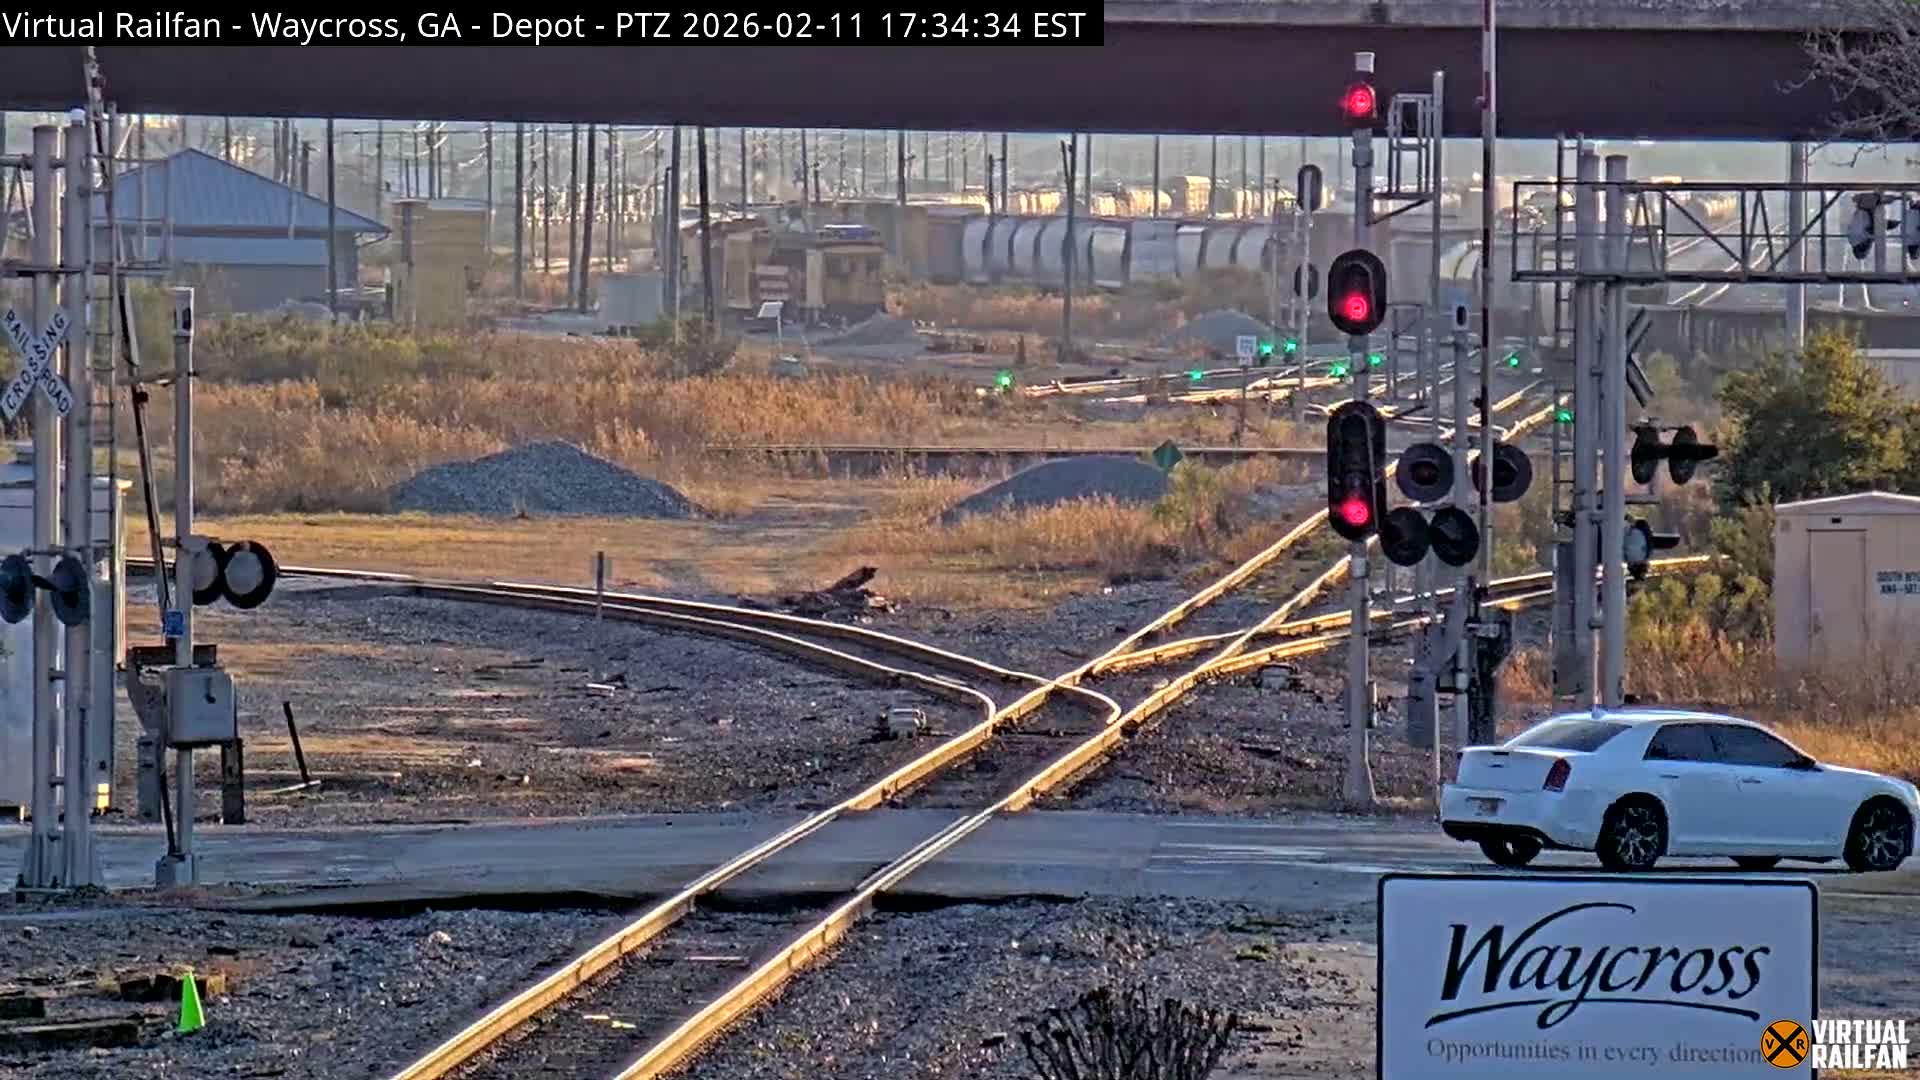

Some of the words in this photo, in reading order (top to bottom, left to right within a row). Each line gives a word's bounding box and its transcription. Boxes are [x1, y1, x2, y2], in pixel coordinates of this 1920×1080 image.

[5, 309, 31, 354] RAIL
[40, 366, 70, 414] ROAD
[5, 312, 66, 411] CROSSING
[1441, 902, 1771, 1030] Waycross
[1427, 1039, 1569, 1063] Opportunities
[1578, 1042, 1597, 1061] in
[1604, 1044, 1659, 1067] every
